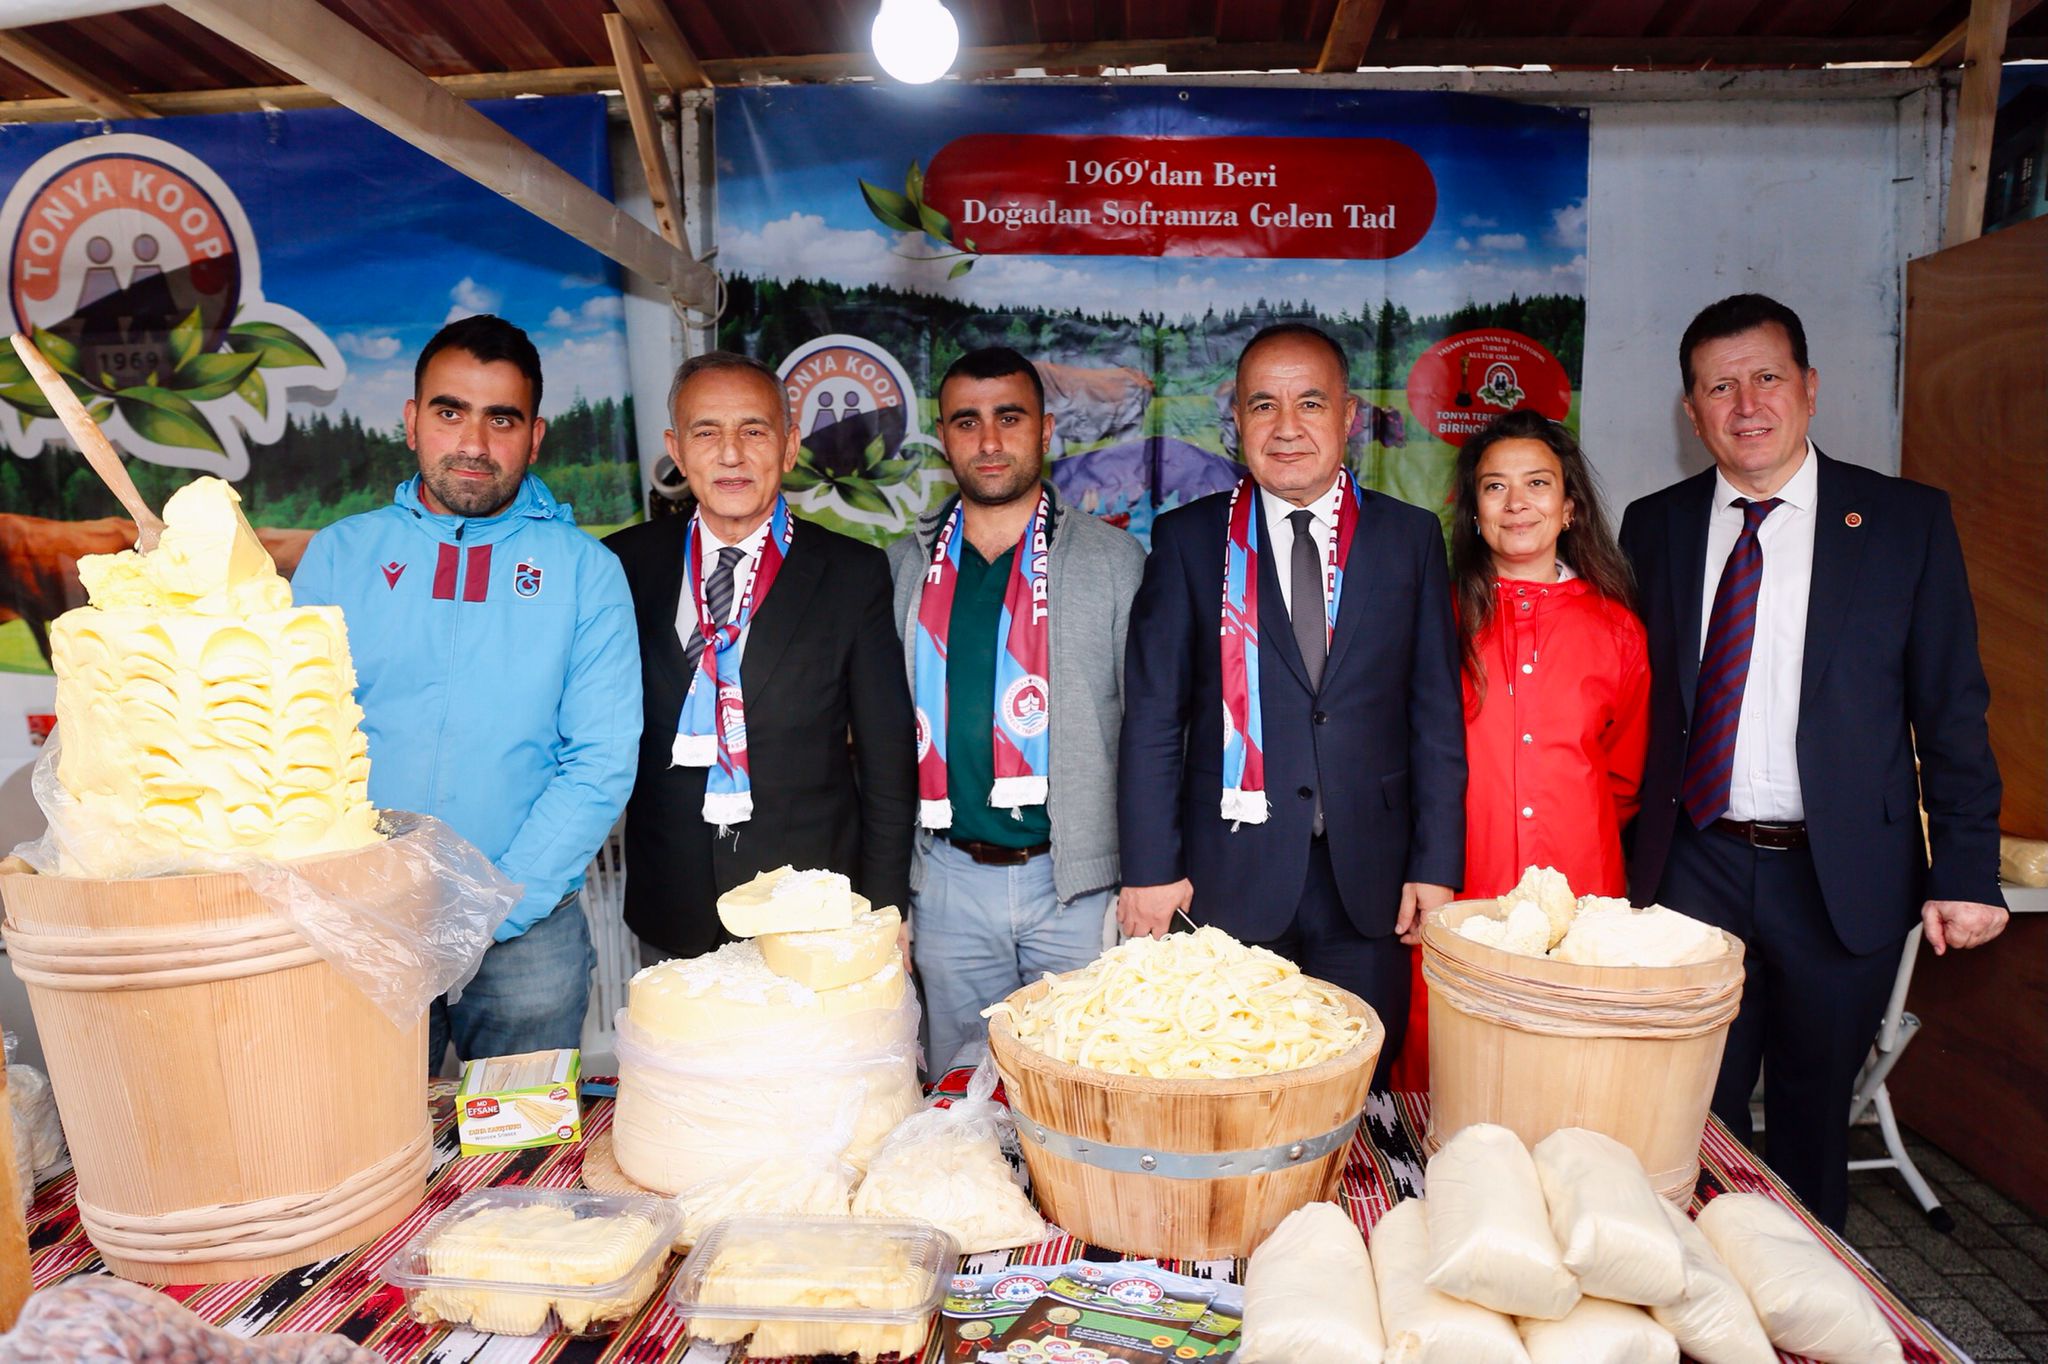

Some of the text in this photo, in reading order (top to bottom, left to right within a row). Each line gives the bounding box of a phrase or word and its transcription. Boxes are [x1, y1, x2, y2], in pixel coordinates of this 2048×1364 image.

[1065, 160, 1277, 187] 1969'dan Beri
[23, 170, 223, 282] TONYA KOOP
[962, 199, 1396, 231] Doğadan Sofranıza Gelen Tad
[99, 351, 158, 370] 1969
[787, 355, 897, 413] ONYA KOOP
[1436, 411, 1470, 420] TONYA
[468, 1105, 499, 1118] EFSANE
